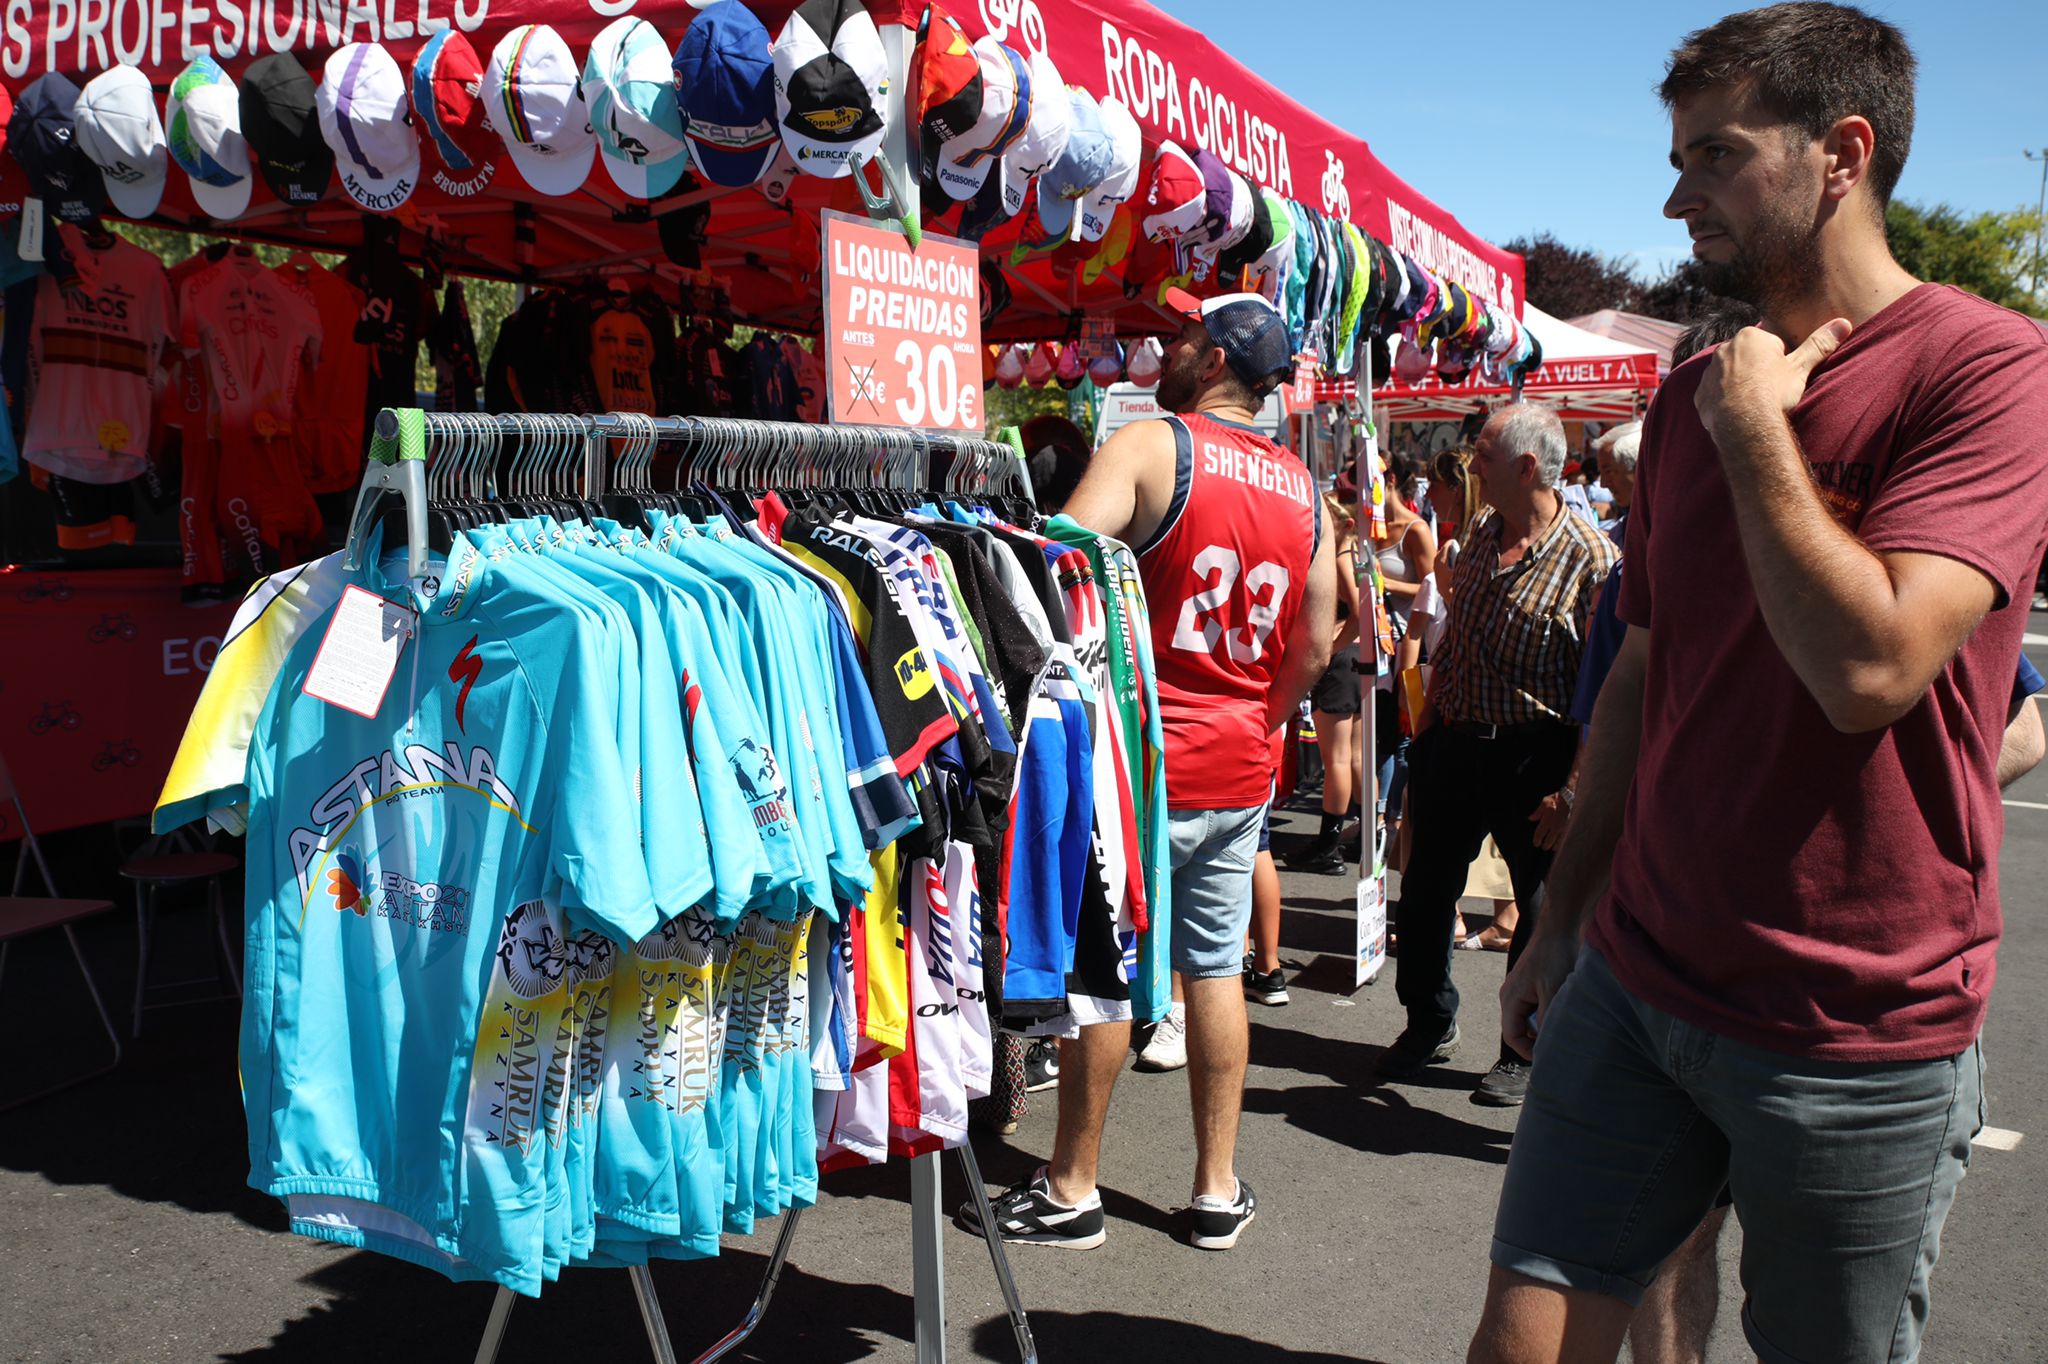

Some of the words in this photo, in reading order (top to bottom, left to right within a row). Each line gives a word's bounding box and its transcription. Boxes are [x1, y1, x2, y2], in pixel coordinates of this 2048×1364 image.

[0, 0, 33, 79] S
[1102, 20, 1188, 141] ROPA
[1189, 76, 1294, 198] CICLISTA
[431, 161, 496, 197] BROOKLYN
[812, 150, 863, 160] MERCATR
[940, 168, 980, 189] Panasonic
[343, 173, 411, 209] MERCIER
[1387, 197, 1413, 260] VISTE
[834, 239, 974, 299] LIQUIDACIÓN
[842, 330, 875, 345] ANTES
[848, 286, 968, 338] PRENDAS
[953, 342, 975, 354] AHORA
[1554, 361, 1632, 382] VUELTA
[894, 339, 977, 429] 30€
[1118, 401, 1155, 414] Tienda
[1811, 461, 1875, 499] SILVER
[440, 545, 478, 617] ASTANA
[810, 526, 907, 616] RALEIGH
[1171, 544, 1290, 665] 23
[401, 785, 444, 798] TEAM
[288, 741, 521, 910] ASTANA
[485, 1001, 513, 1143] KAZYNA
[681, 971, 706, 1114] SAMRUK
[503, 1008, 539, 1158] SAMRUK
